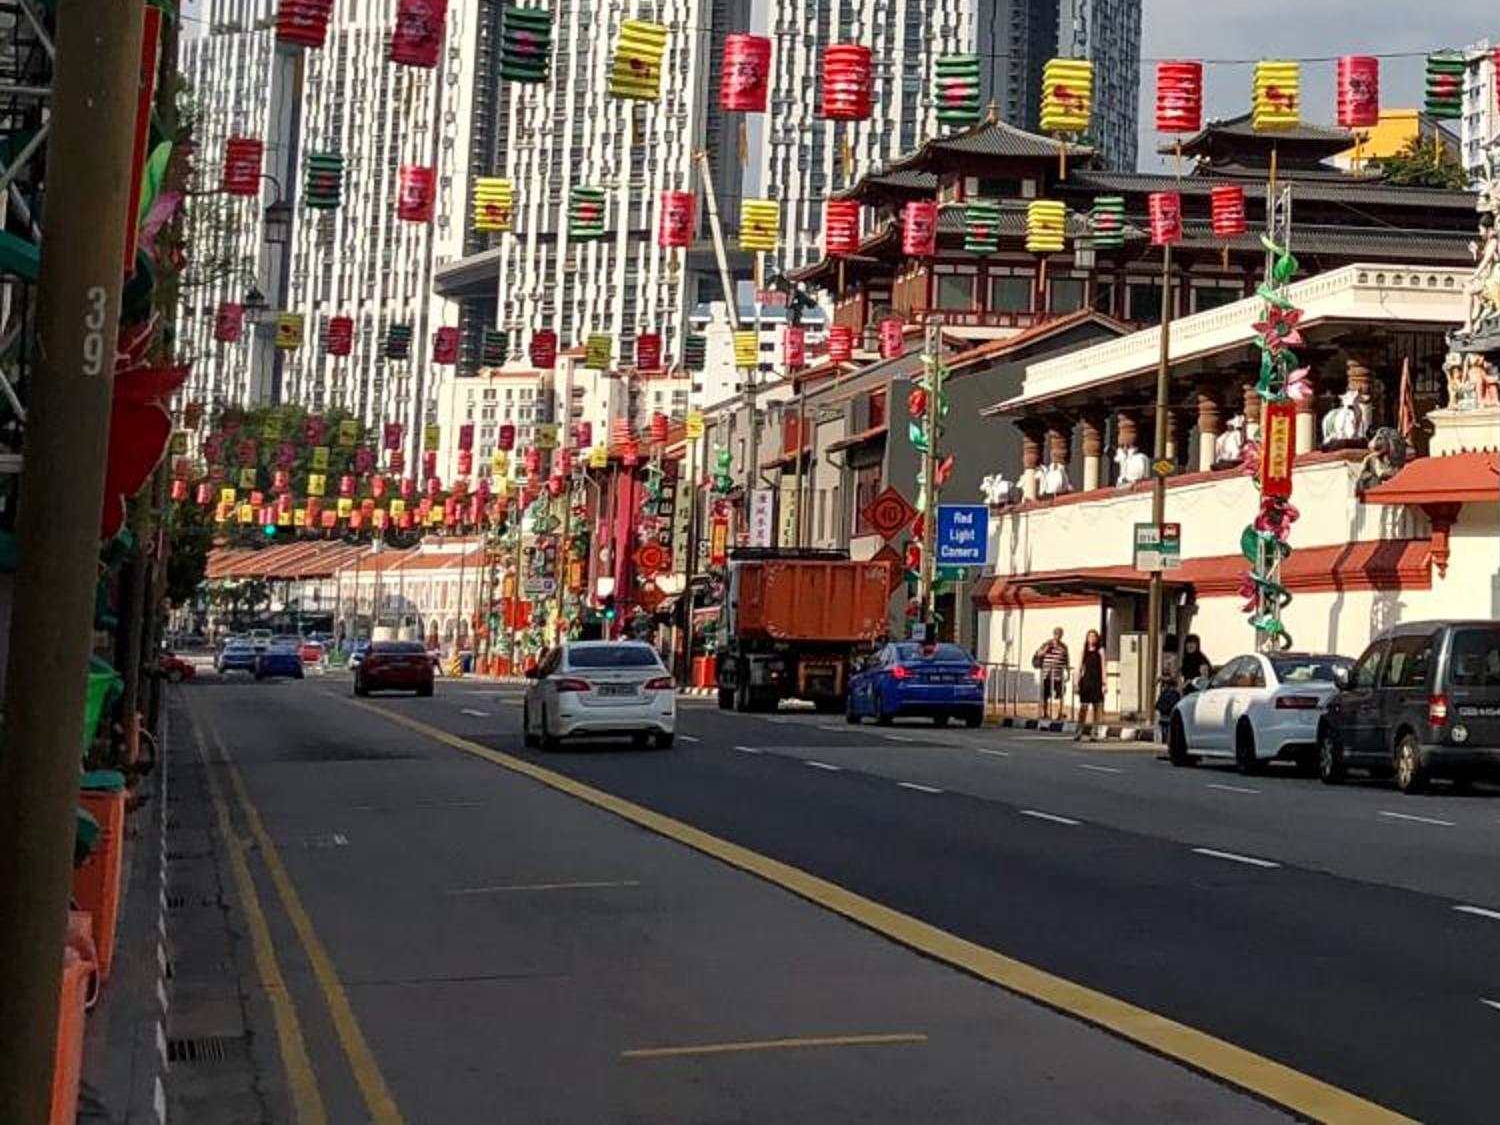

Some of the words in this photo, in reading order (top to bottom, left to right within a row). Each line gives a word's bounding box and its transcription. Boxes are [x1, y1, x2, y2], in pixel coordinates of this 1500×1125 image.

[82, 286, 107, 375] 39
[953, 512, 974, 525] Red
[949, 528, 976, 544] Light
[941, 547, 980, 559] Camera
